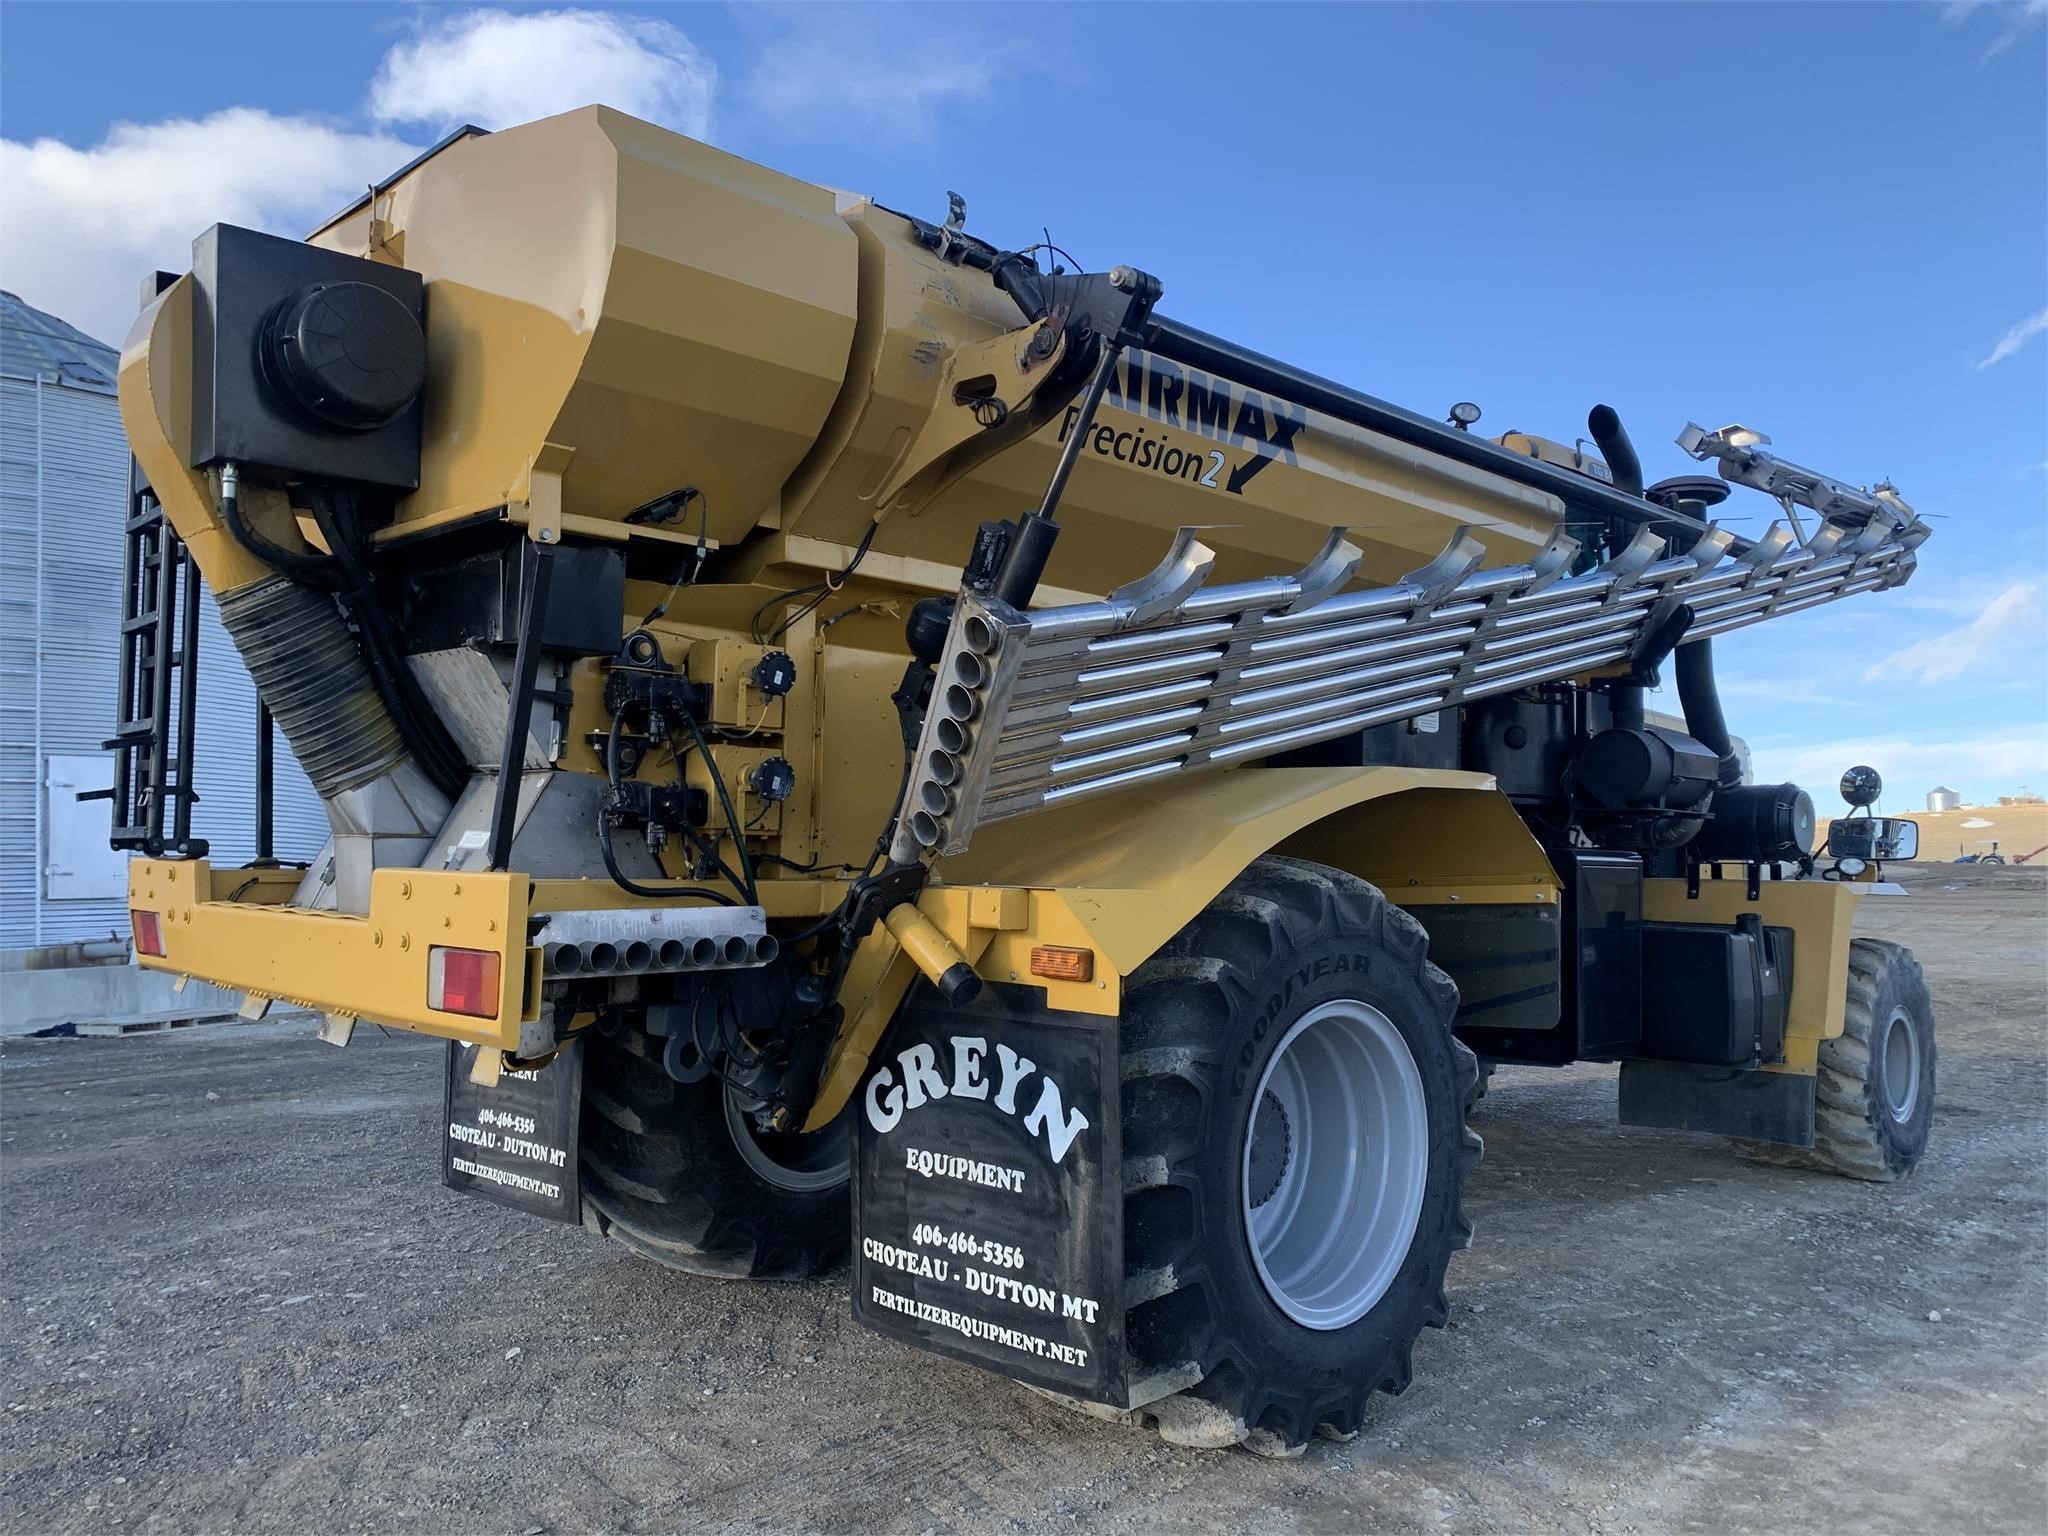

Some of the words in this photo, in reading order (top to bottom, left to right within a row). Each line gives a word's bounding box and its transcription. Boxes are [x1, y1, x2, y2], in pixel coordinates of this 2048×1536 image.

[478, 1108, 535, 1134] 406-466-5356
[865, 1036, 1089, 1163] GREYN
[449, 1123, 496, 1149] CHOTEAU
[503, 1136, 549, 1162] DUTTON
[549, 1149, 567, 1168] MT
[452, 1157, 560, 1198] FERTILIZEREQUIPMENT.NET
[906, 1148, 1025, 1193] EQUIPMENT
[912, 1223, 1025, 1269] 406-466-5356
[863, 1237, 949, 1281] CHOTEAU
[965, 1267, 1056, 1313] DUTTON
[1062, 1294, 1099, 1324] MT
[872, 1286, 1087, 1367] FERTILIZEREQUIPMENT.NET
